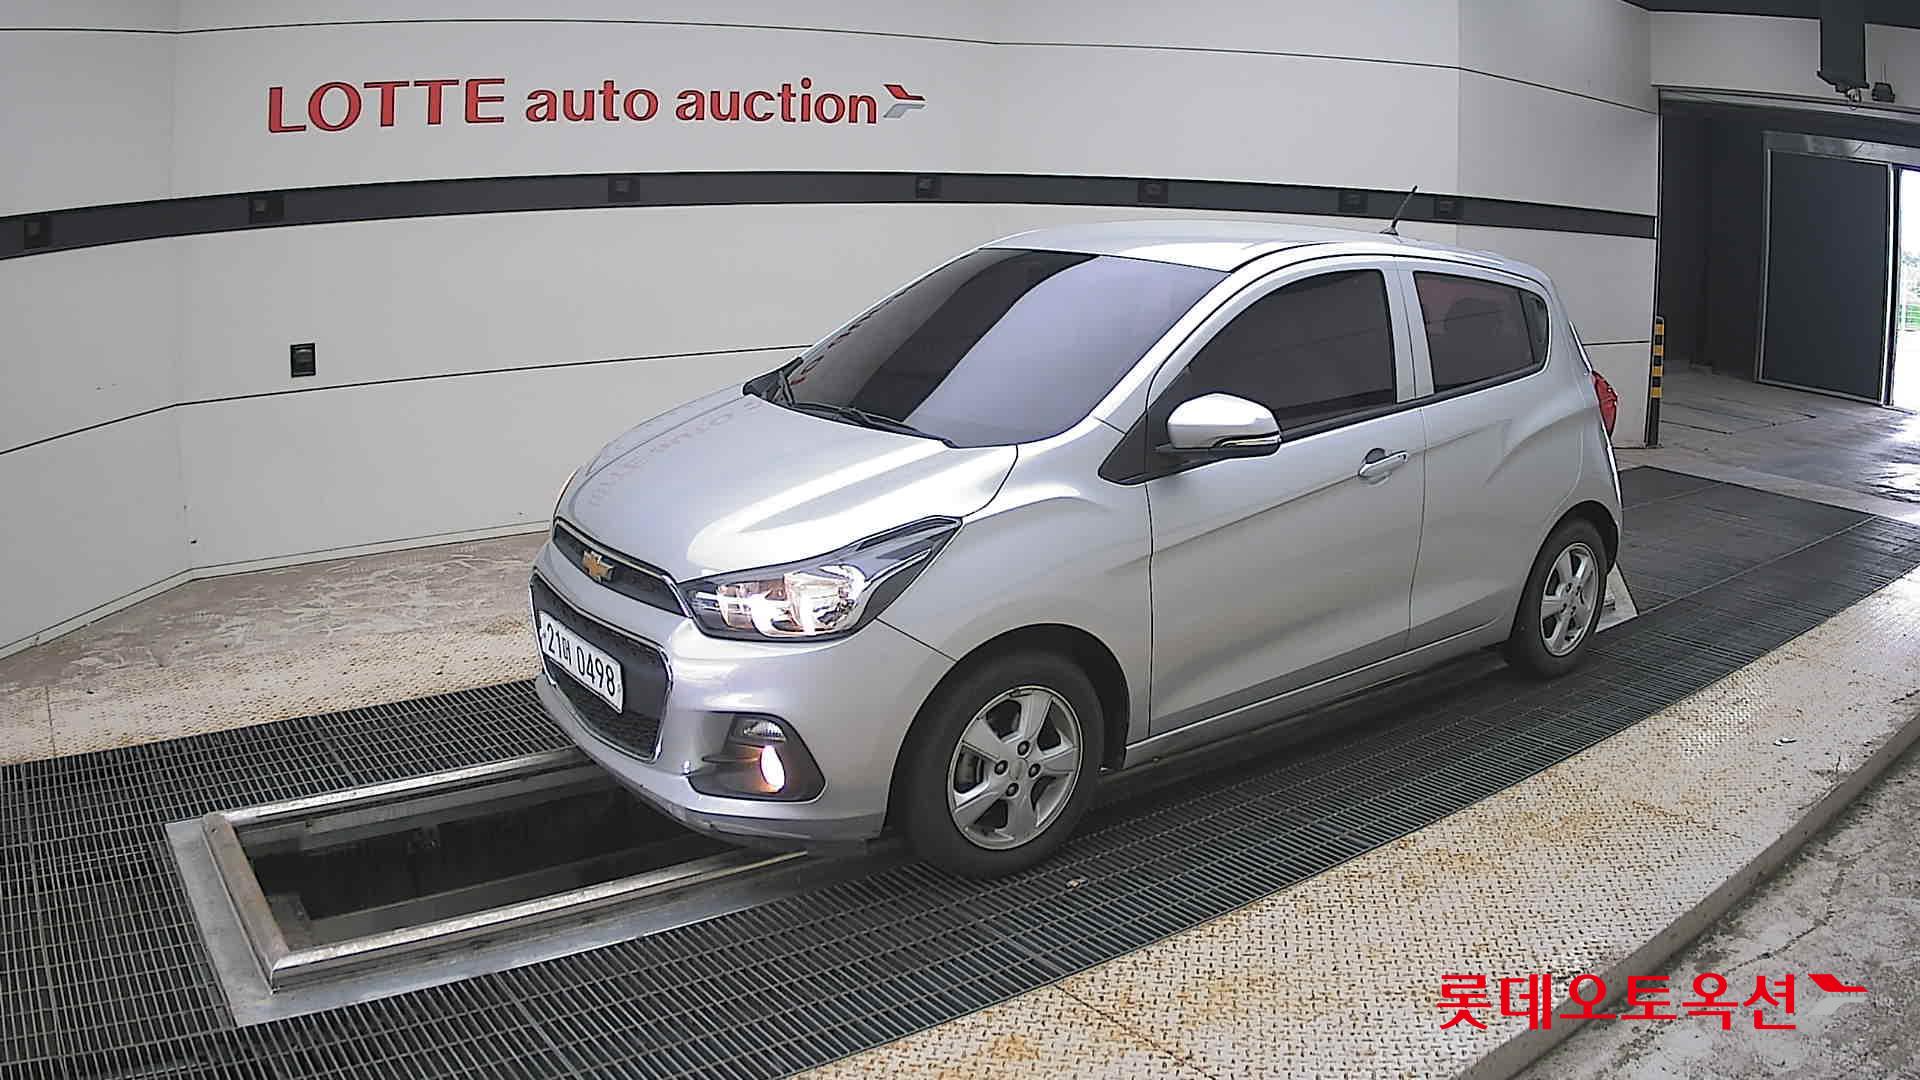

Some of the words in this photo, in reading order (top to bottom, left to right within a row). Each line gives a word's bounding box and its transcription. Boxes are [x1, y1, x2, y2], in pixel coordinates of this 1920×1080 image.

[268, 78, 505, 133] LOTTE
[526, 79, 658, 123] auto
[676, 78, 878, 124] auction
[577, 645, 615, 697] 0498
